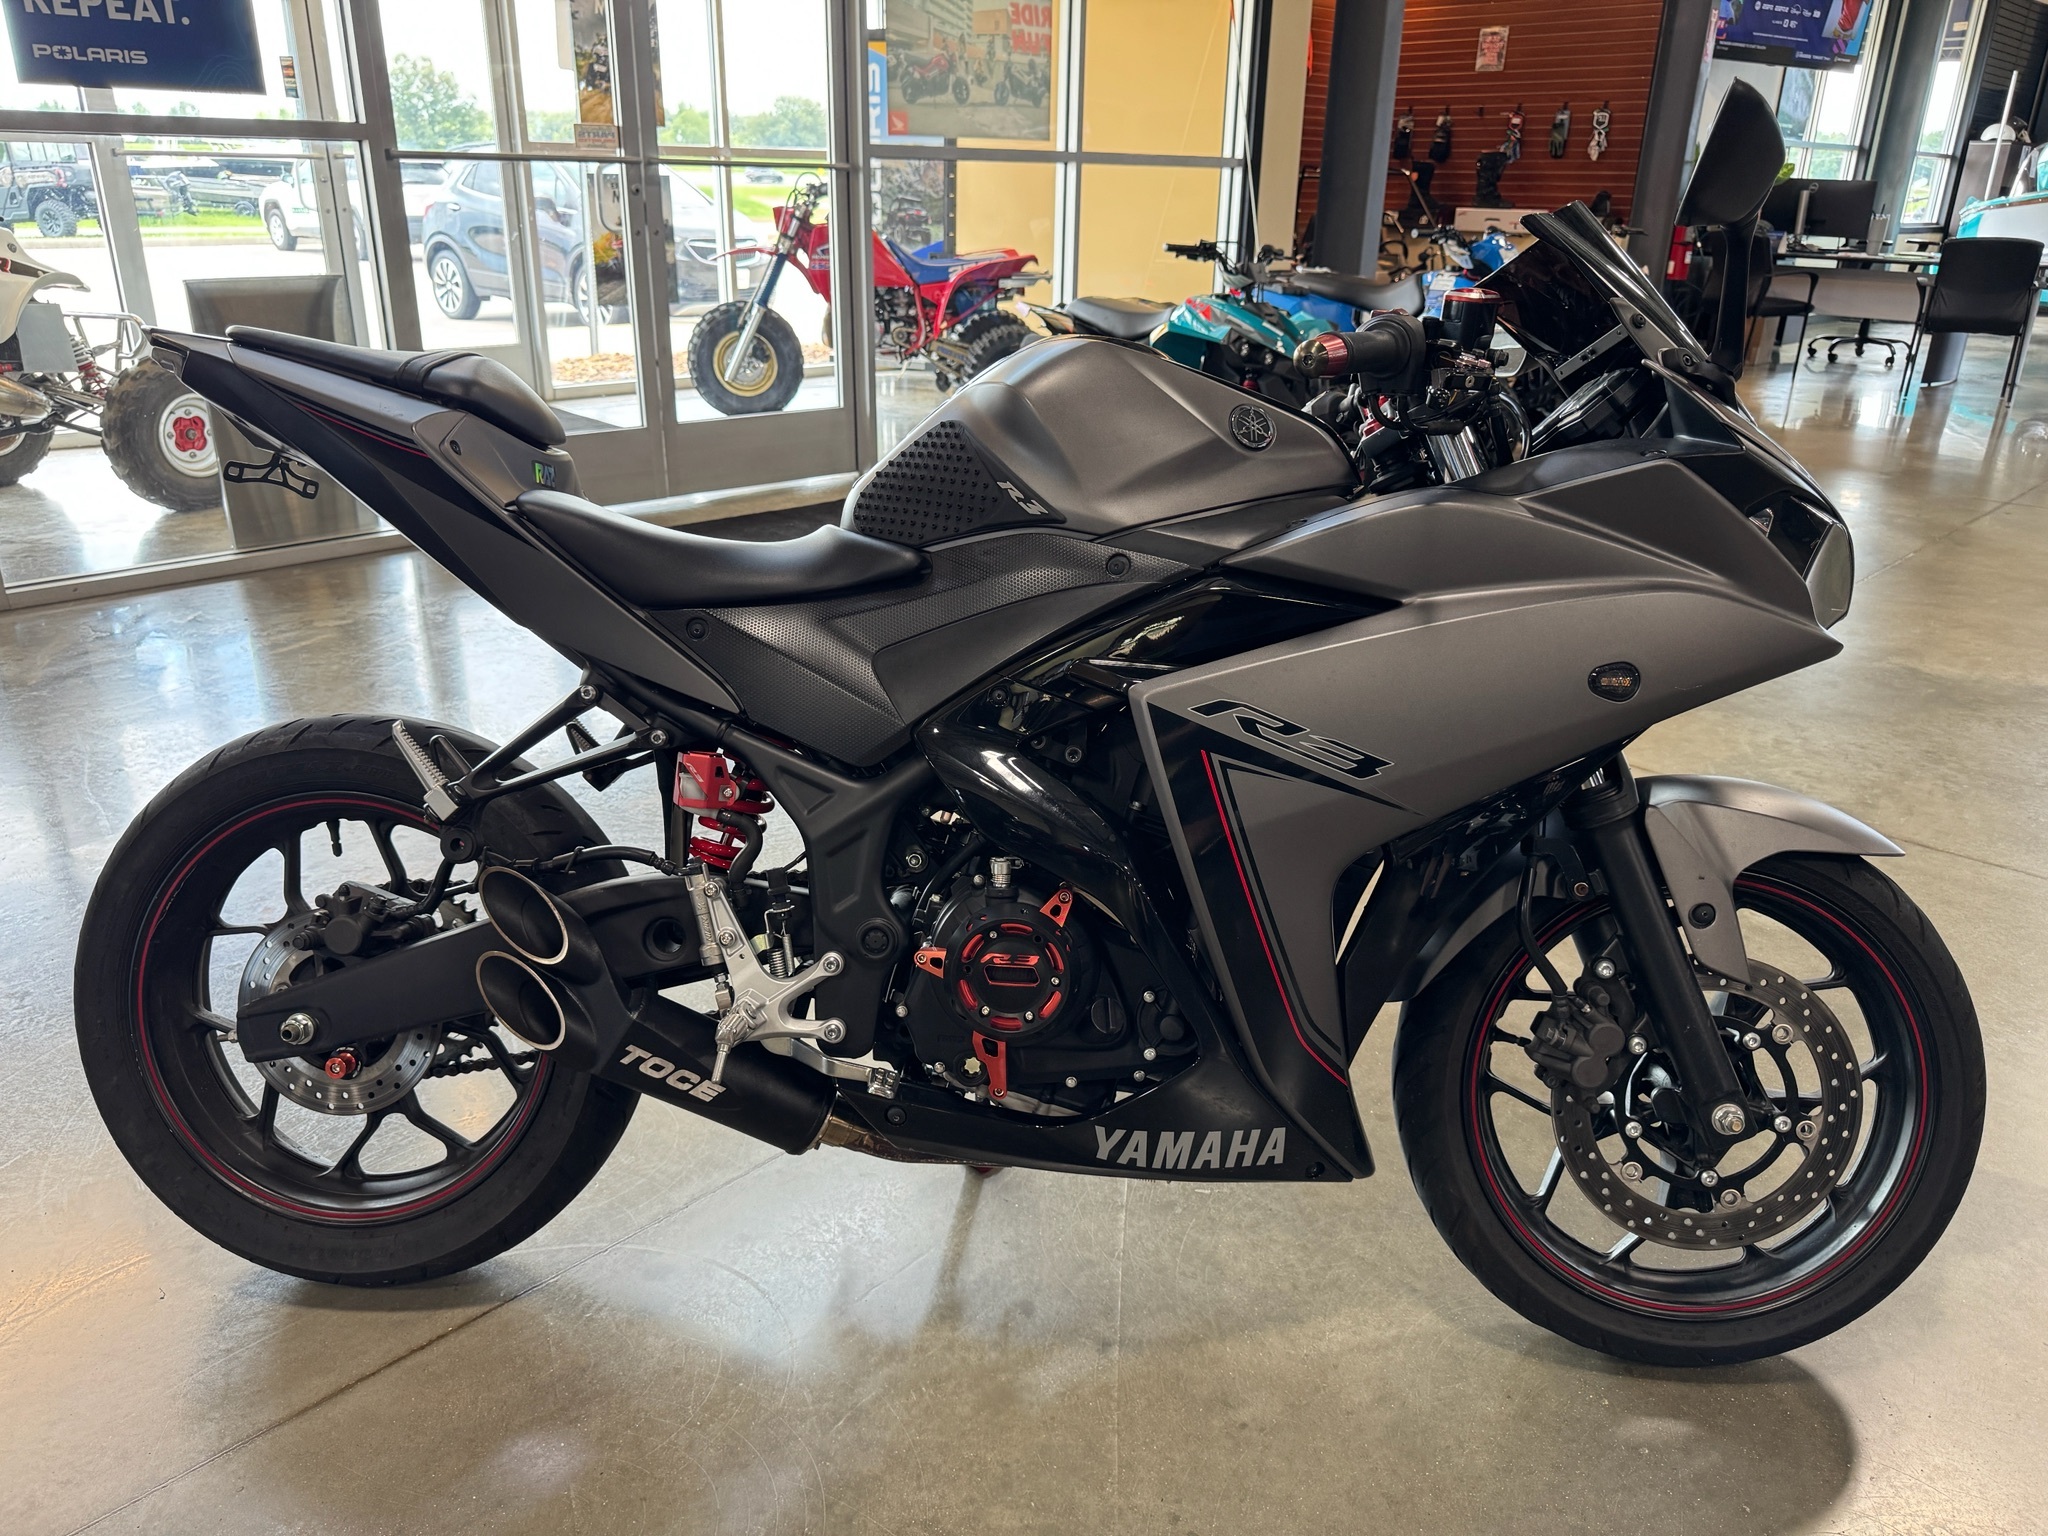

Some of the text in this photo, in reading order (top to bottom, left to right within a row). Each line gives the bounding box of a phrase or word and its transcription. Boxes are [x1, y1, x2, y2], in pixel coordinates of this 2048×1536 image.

[31, 43, 149, 65] POLARIS
[980, 953, 1040, 966] R3
[619, 1044, 727, 1103] TOCE
[1094, 1125, 1287, 1170] YAMAHA
